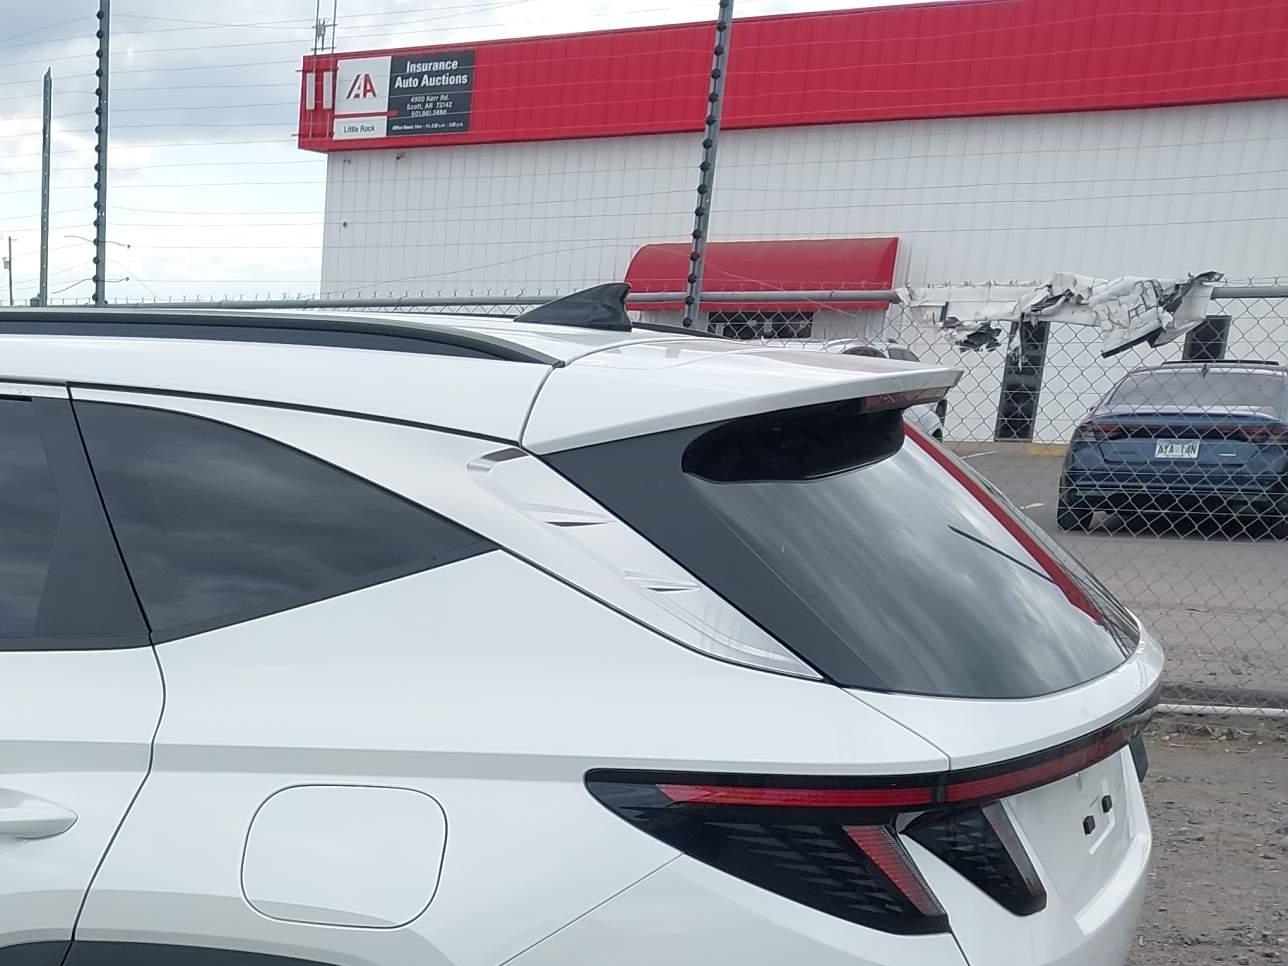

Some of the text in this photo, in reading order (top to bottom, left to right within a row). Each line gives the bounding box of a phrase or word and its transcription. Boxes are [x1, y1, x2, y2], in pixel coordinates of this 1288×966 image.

[406, 60, 458, 73] Insurance
[394, 73, 468, 89] Auto Auctions
[344, 125, 376, 134] Little Rock
